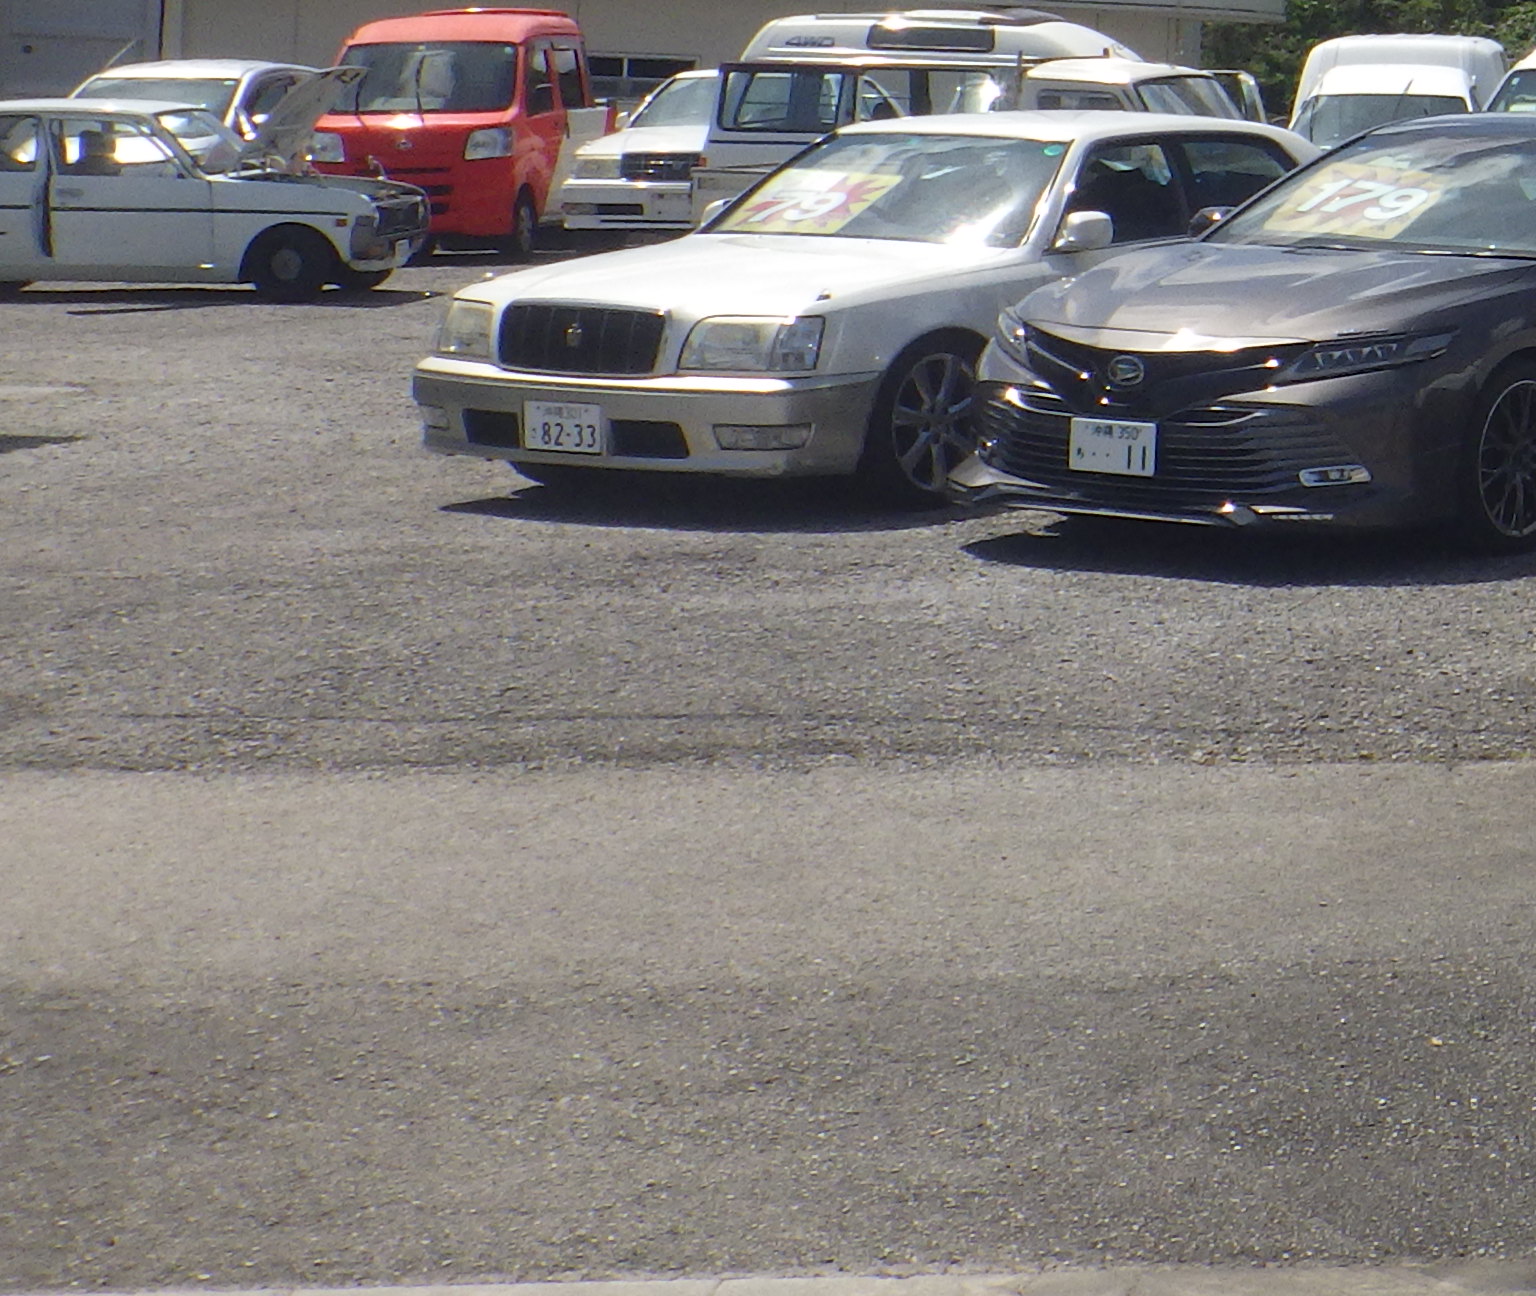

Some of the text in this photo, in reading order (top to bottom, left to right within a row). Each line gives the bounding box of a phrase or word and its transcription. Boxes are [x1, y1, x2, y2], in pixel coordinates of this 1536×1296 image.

[748, 191, 847, 222] 79
[1295, 178, 1429, 220] 179
[541, 421, 597, 449] 82-33
